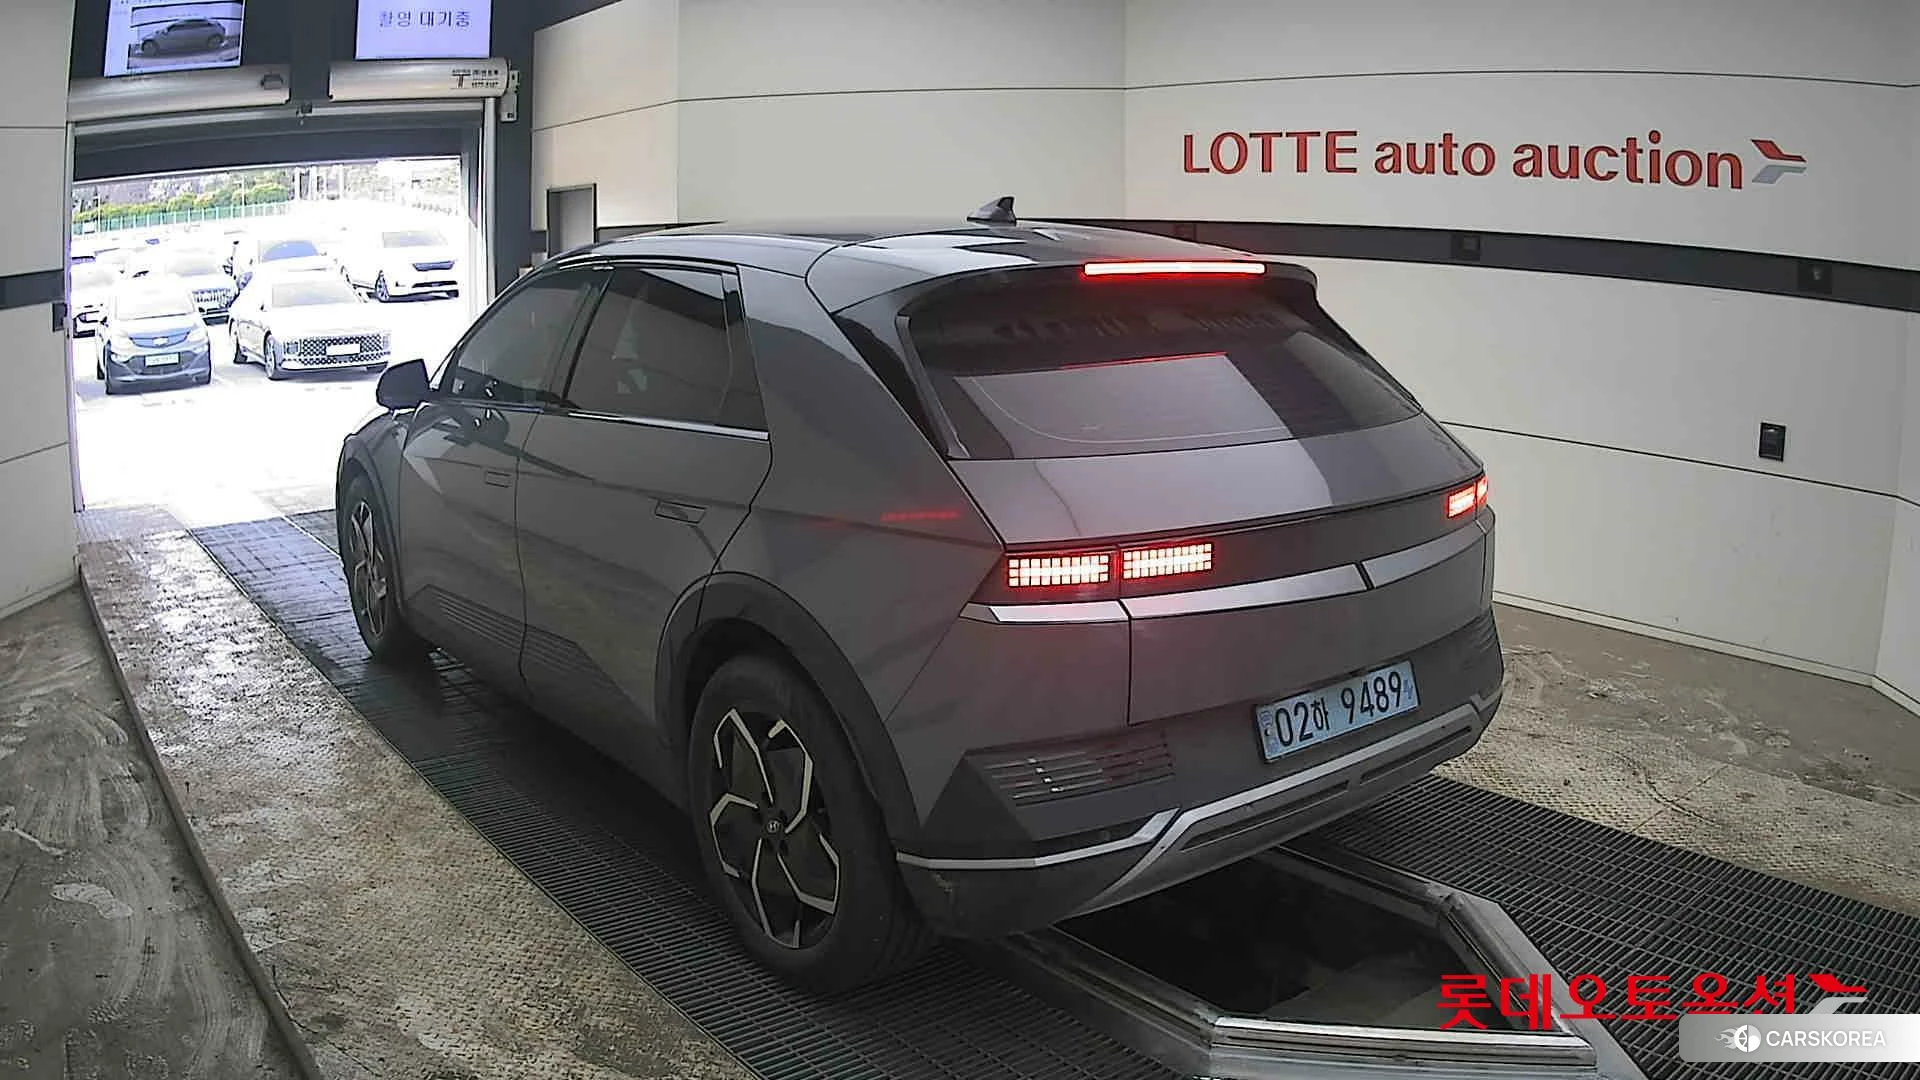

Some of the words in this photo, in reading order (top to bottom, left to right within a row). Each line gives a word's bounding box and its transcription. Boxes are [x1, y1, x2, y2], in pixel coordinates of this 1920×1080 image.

[420, 10, 470, 28] 대기중
[1183, 130, 1358, 175] LOTTE
[1374, 132, 1497, 177] auto
[1511, 129, 1744, 190] auction
[1275, 697, 1331, 747] 02하
[1340, 671, 1403, 725] 9489
